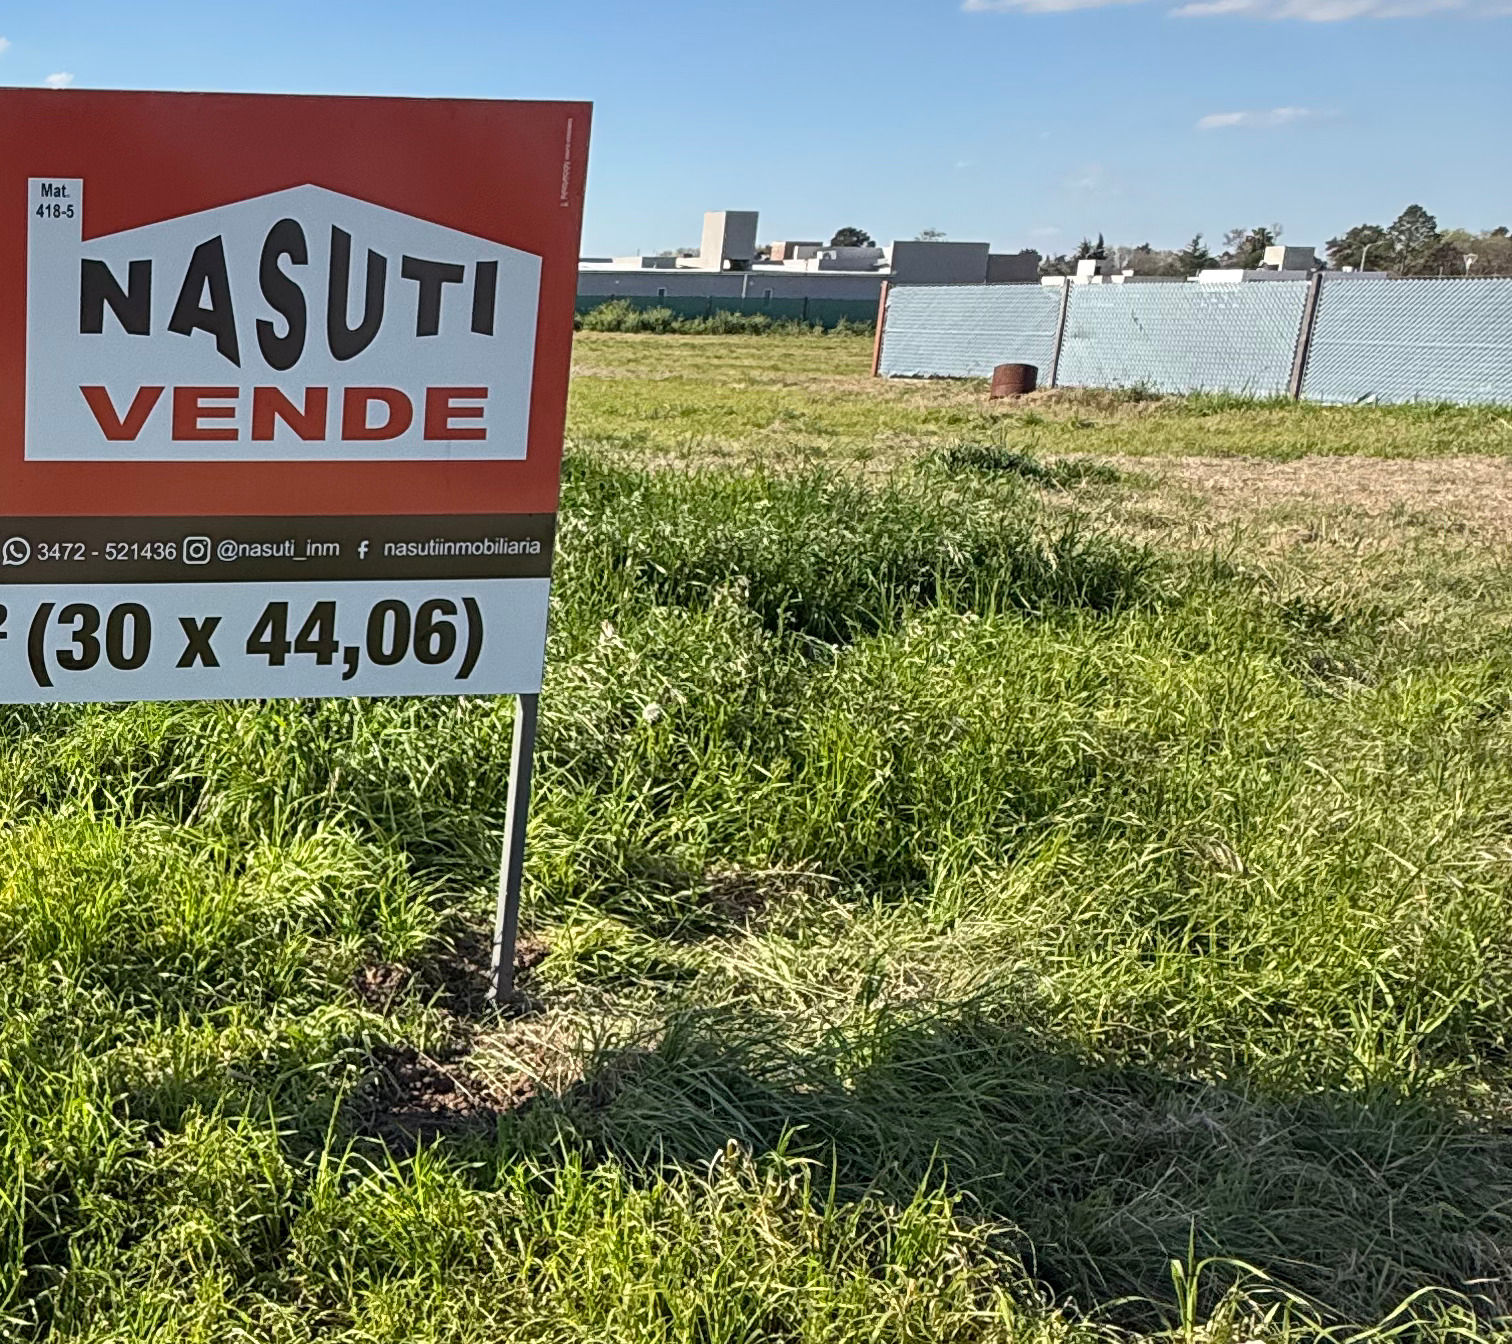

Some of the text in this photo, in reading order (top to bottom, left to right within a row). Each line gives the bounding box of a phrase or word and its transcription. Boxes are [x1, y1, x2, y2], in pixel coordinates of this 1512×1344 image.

[40, 183, 70, 199] Mat.
[35, 204, 75, 220] 418-5
[79, 218, 498, 372] NASUTI
[79, 386, 488, 442] VENDE
[37, 542, 86, 561] 3472
[105, 541, 177, 560] 521436
[216, 540, 341, 562] @nasuti_inm
[384, 537, 542, 558] nasutiinmobiliaria
[27, 600, 152, 688] (30
[177, 615, 222, 666] x
[245, 596, 484, 682] 44,06)
